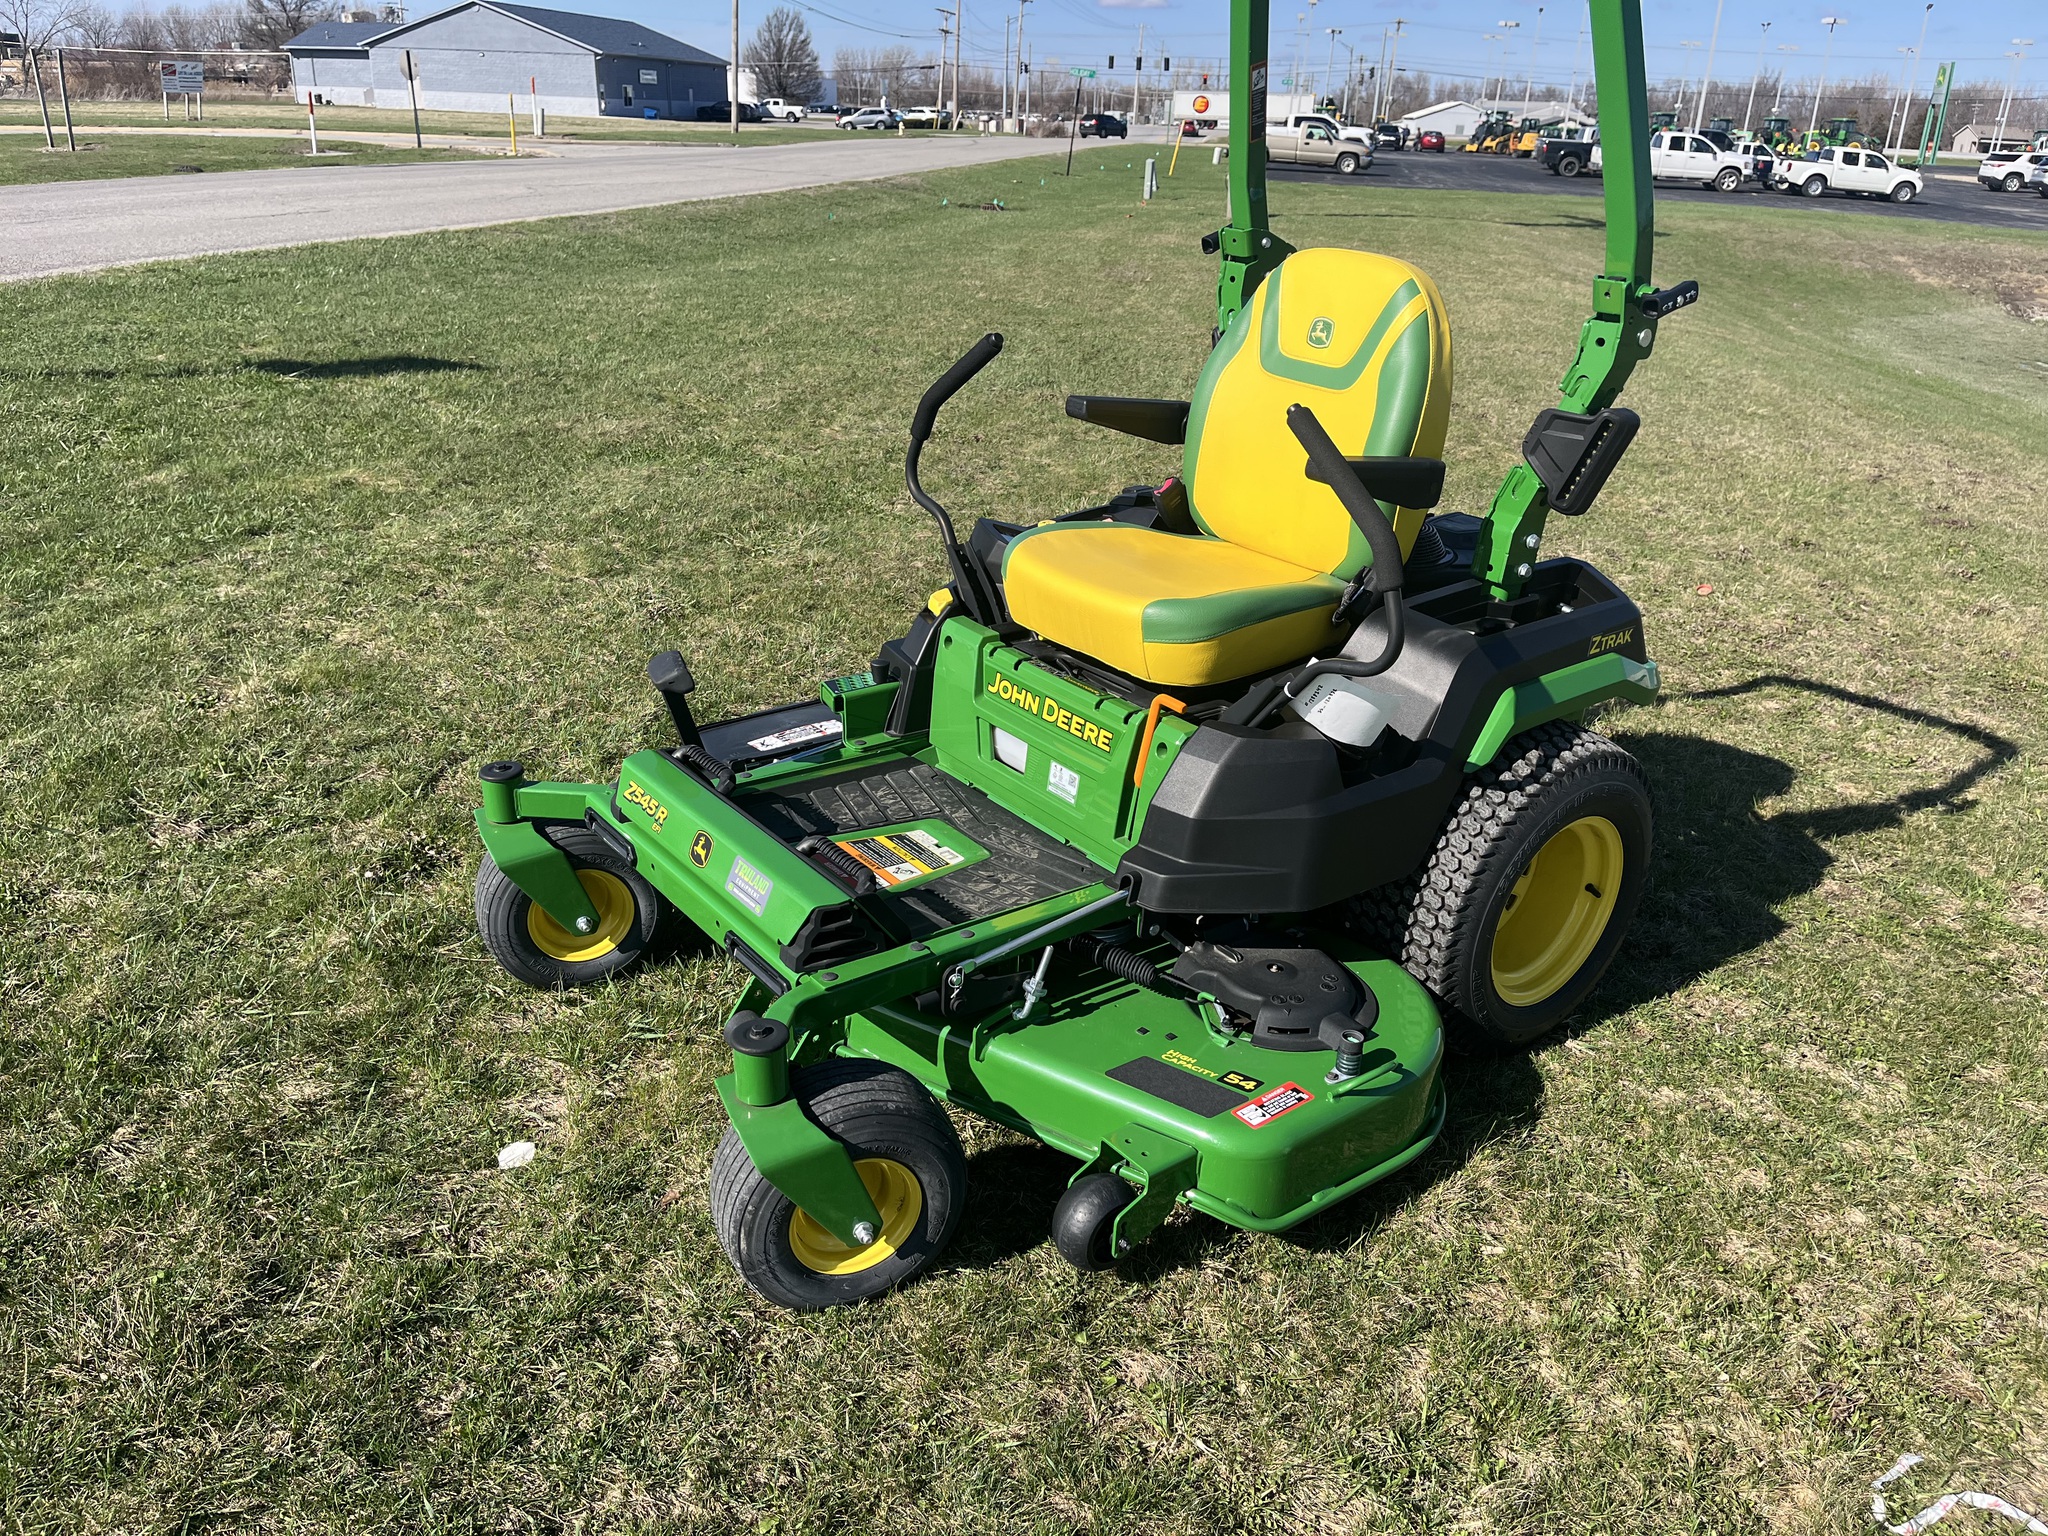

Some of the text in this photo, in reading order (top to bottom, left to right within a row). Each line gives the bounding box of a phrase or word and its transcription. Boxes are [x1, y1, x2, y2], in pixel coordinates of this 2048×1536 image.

[1589, 628, 1634, 655] ZTRAK
[987, 671, 1041, 716] JOHN
[1041, 696, 1115, 754] DEERE
[623, 781, 669, 825] Z545 R
[651, 822, 662, 835] EFI
[735, 860, 770, 896] TRULAND
[1161, 1054, 1219, 1078] CAPACITY
[1166, 1049, 1198, 1064] HIGH
[1223, 1073, 1258, 1091] 54
